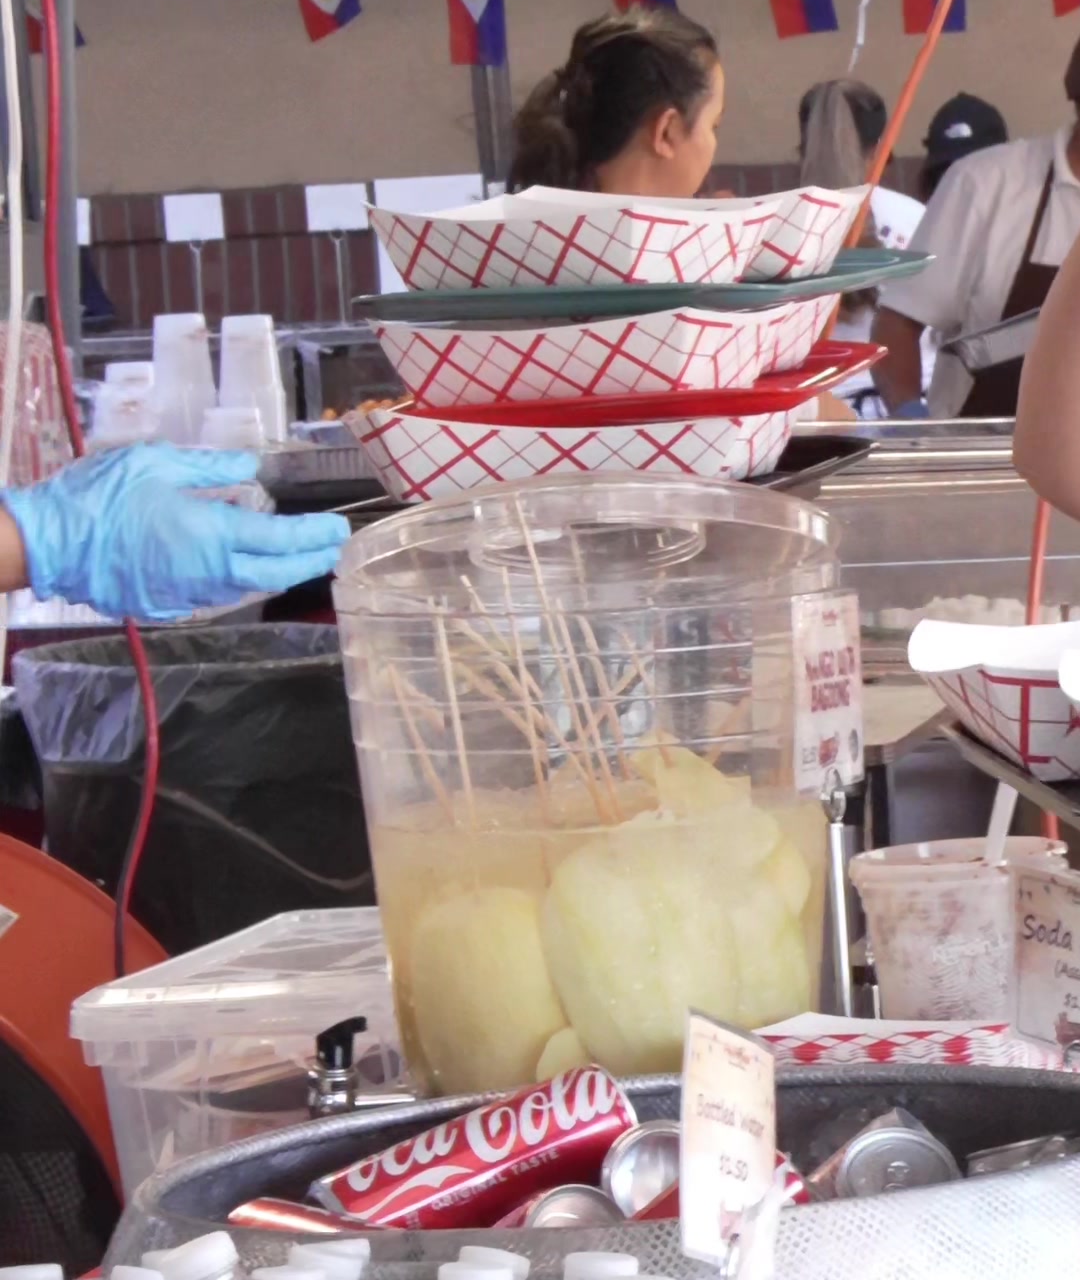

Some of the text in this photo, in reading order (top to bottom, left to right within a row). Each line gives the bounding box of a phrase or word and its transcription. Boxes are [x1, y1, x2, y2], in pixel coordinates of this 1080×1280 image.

[1023, 914, 1073, 951] Soda
[431, 1147, 560, 1211] ORIGINAL TASTE
